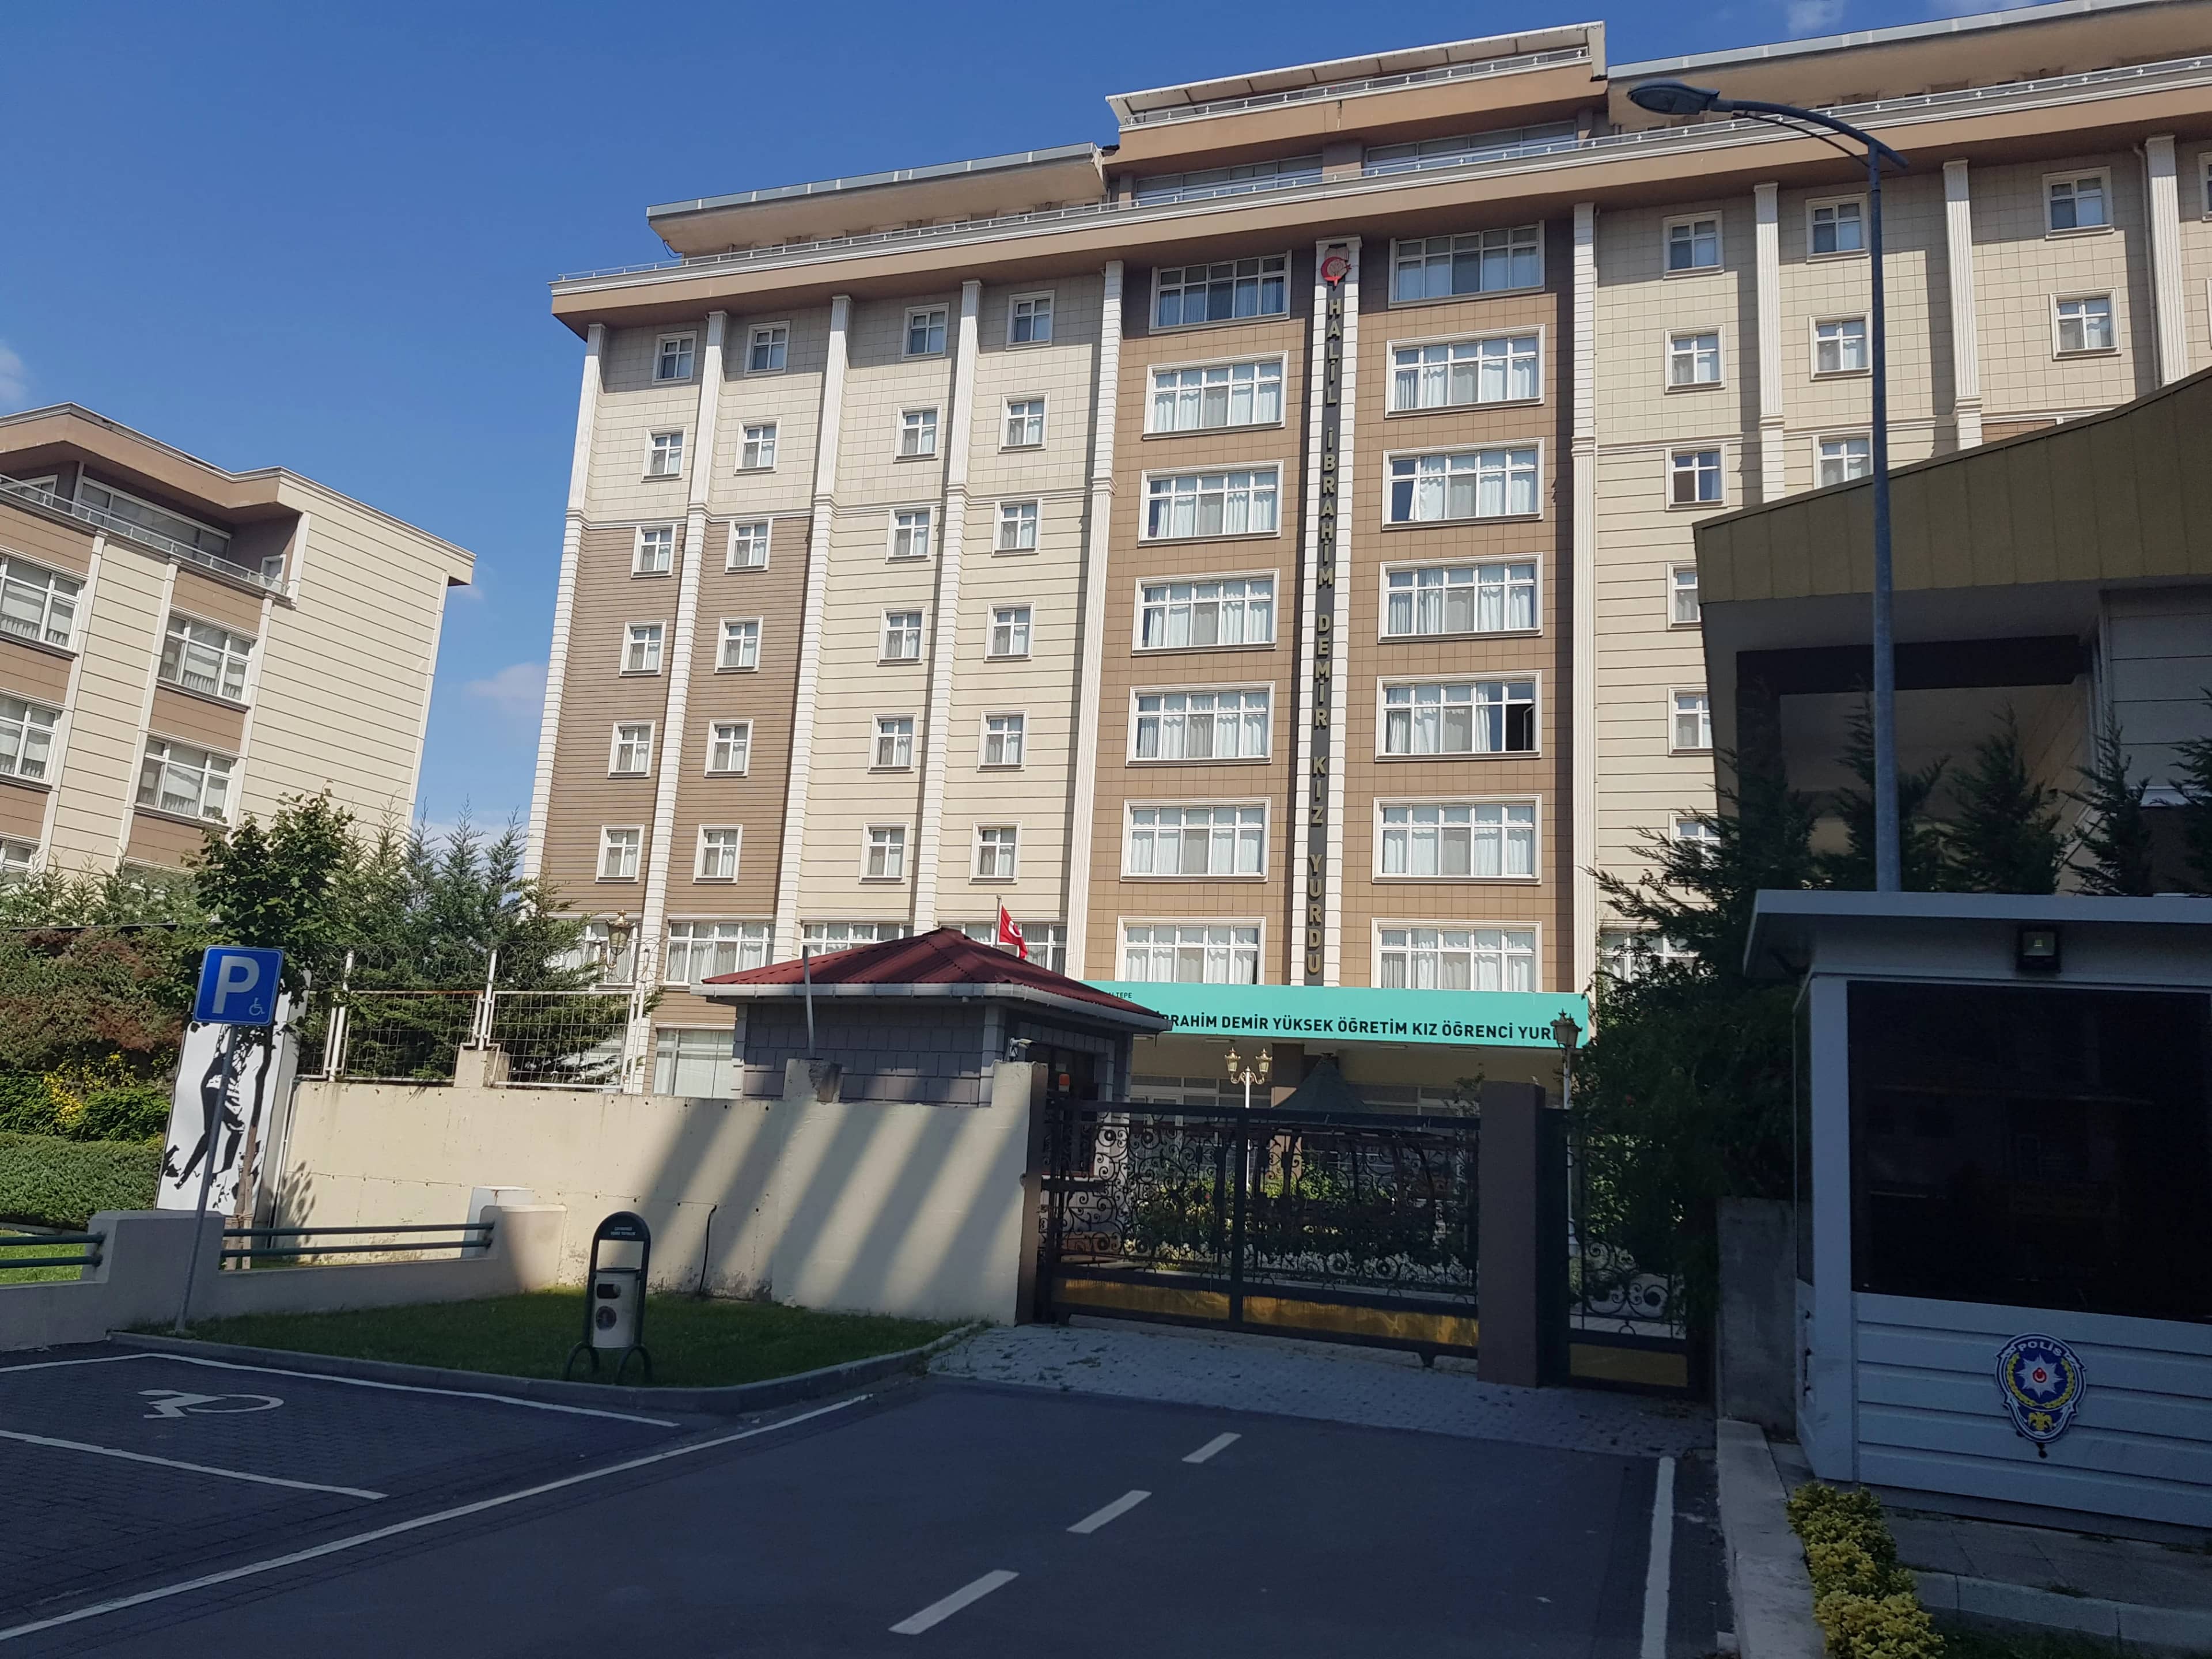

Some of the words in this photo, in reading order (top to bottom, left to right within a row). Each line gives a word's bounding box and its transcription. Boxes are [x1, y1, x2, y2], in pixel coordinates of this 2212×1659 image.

[1327, 298, 1342, 404] HALİL
[1318, 427, 1336, 586] İBRAHİM
[1315, 614, 1330, 727] DEMİR
[1312, 756, 1325, 824] KIZ
[1307, 854, 1323, 974] YURDU
[211, 955, 260, 1014] P
[1156, 1010, 1217, 1027] RAHİM
[1222, 1013, 1268, 1030] DEMİR
[1272, 1014, 1334, 1032] YÜKSEK
[1338, 1017, 1407, 1035] ÖĞRETİM
[1412, 1022, 1437, 1036] KIZ
[1442, 1020, 1513, 1039] ÖĞRENCİ
[2018, 1341, 2062, 1357] POLİS
